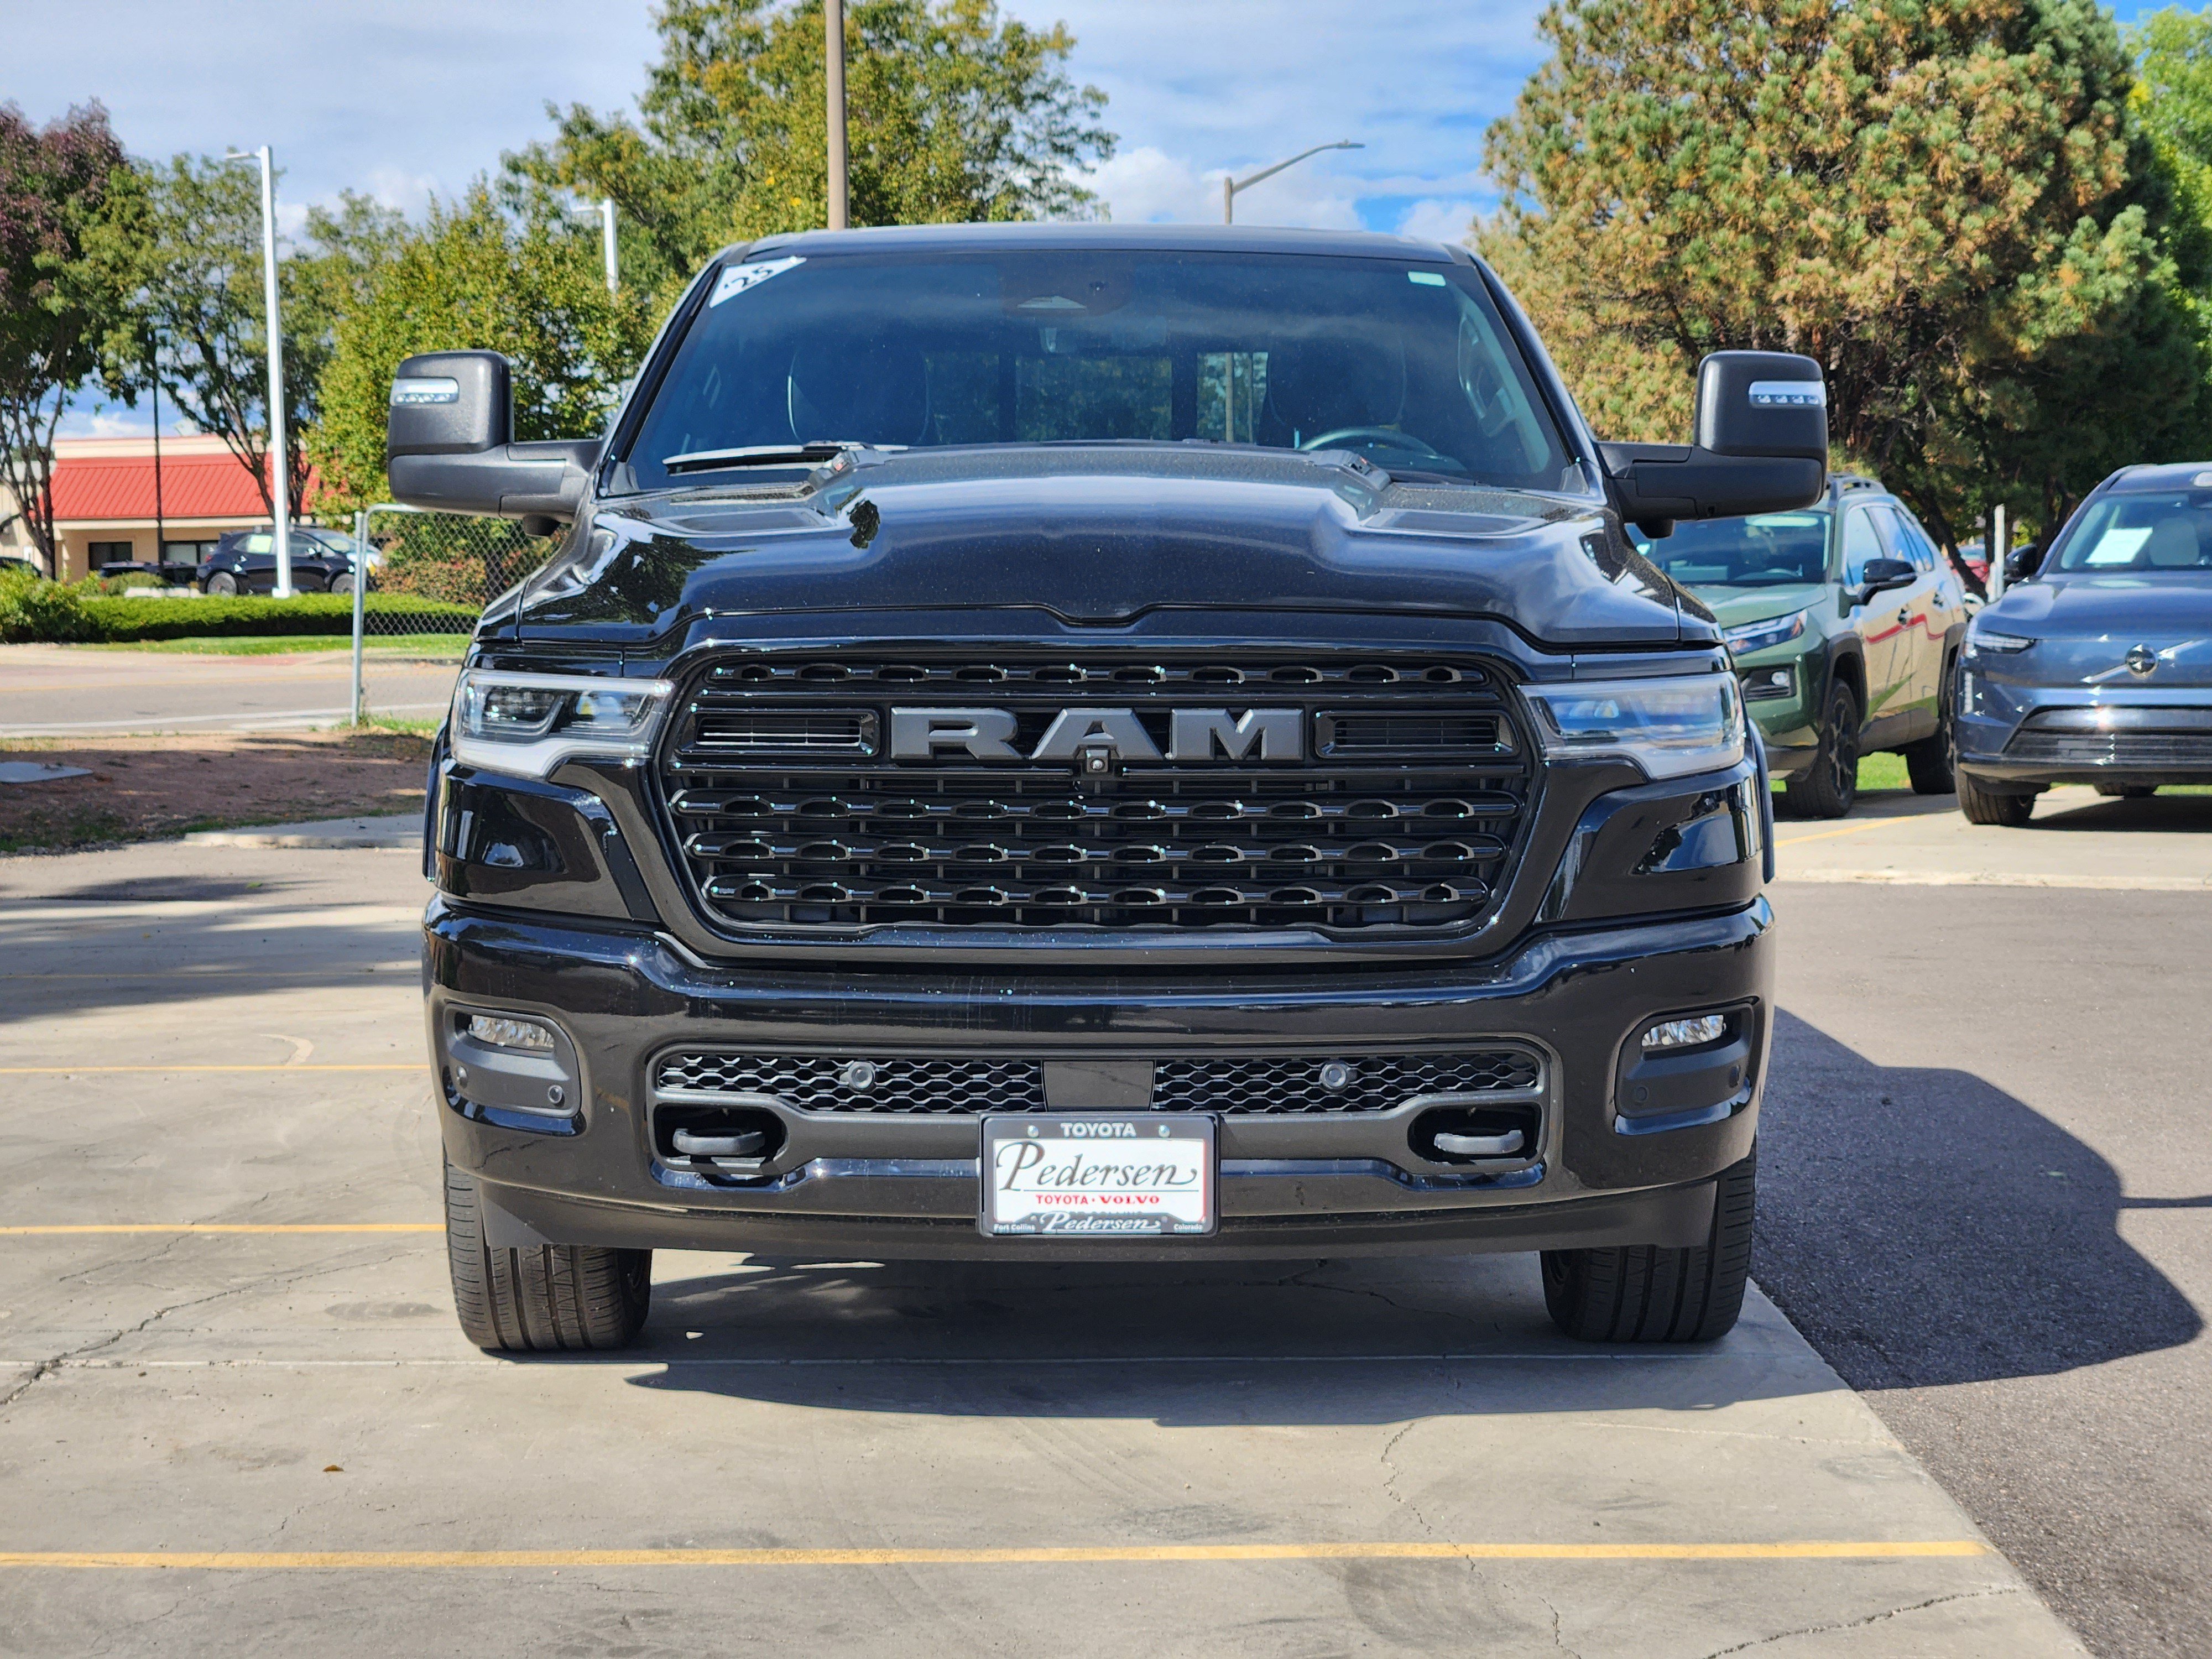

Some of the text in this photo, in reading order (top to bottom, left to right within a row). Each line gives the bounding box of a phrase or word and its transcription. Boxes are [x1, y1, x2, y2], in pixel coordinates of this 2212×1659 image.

[890, 707, 1305, 760] RAM
[1060, 1123, 1136, 1138] TOYOTA
[997, 1141, 1197, 1191] Pedersen
[1036, 1194, 1160, 1204] TOYOTA VOLVO
[994, 1223, 1036, 1232] Fort Collins
[1039, 1211, 1161, 1233] Pedersen
[1173, 1223, 1203, 1232] Colorado
